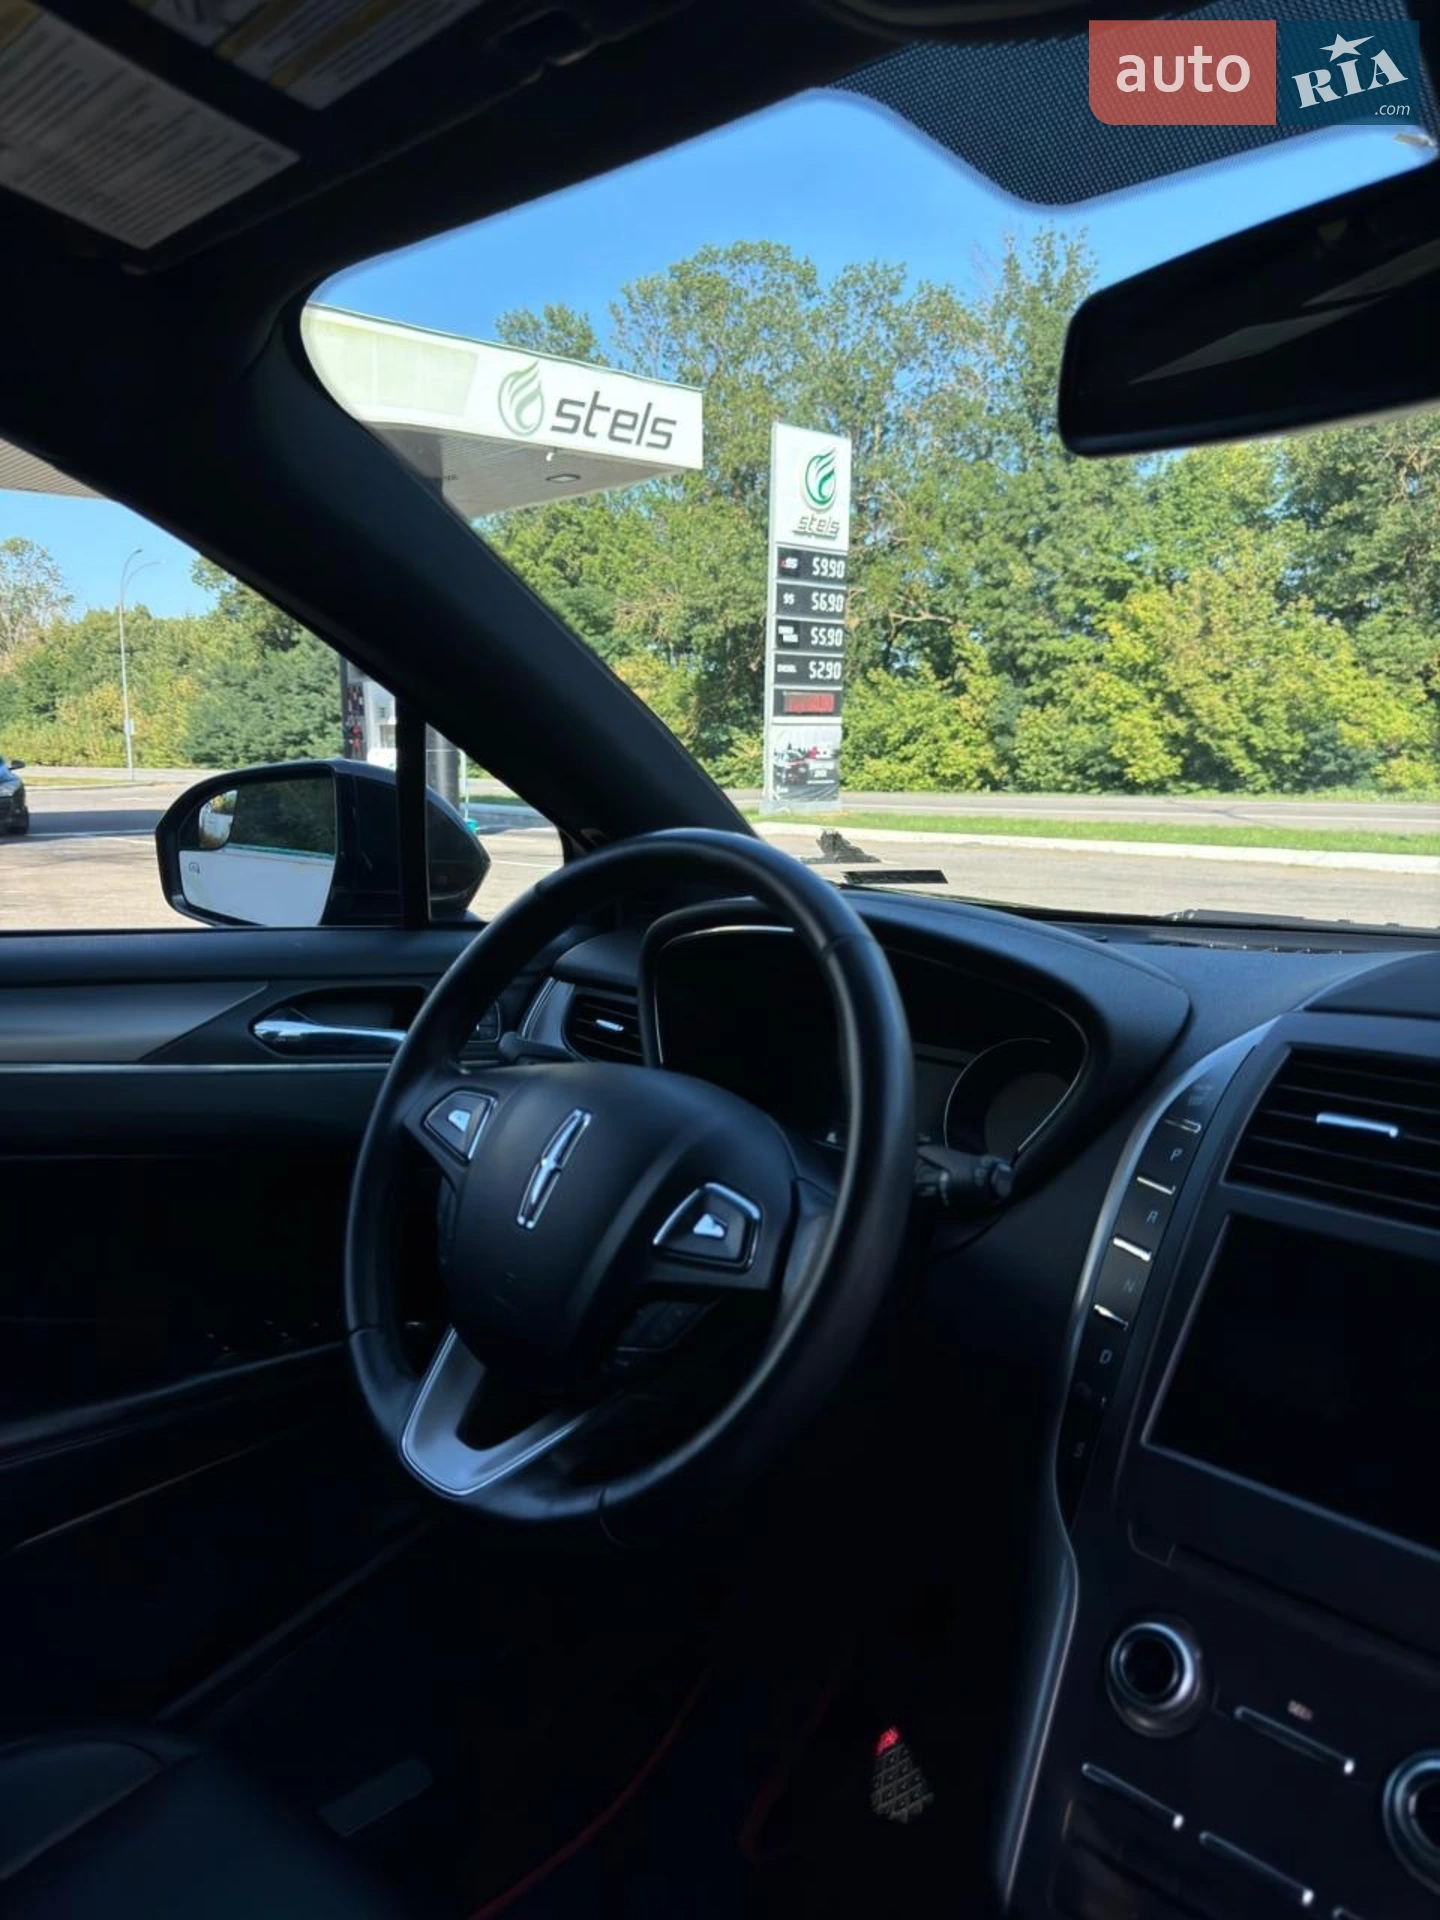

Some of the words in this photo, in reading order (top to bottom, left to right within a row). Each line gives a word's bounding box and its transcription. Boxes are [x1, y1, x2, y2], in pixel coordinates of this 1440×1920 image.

[550, 390, 678, 451] stels
[795, 513, 840, 536] stels
[1170, 1148, 1183, 1162] P
[1146, 1210, 1158, 1224] R
